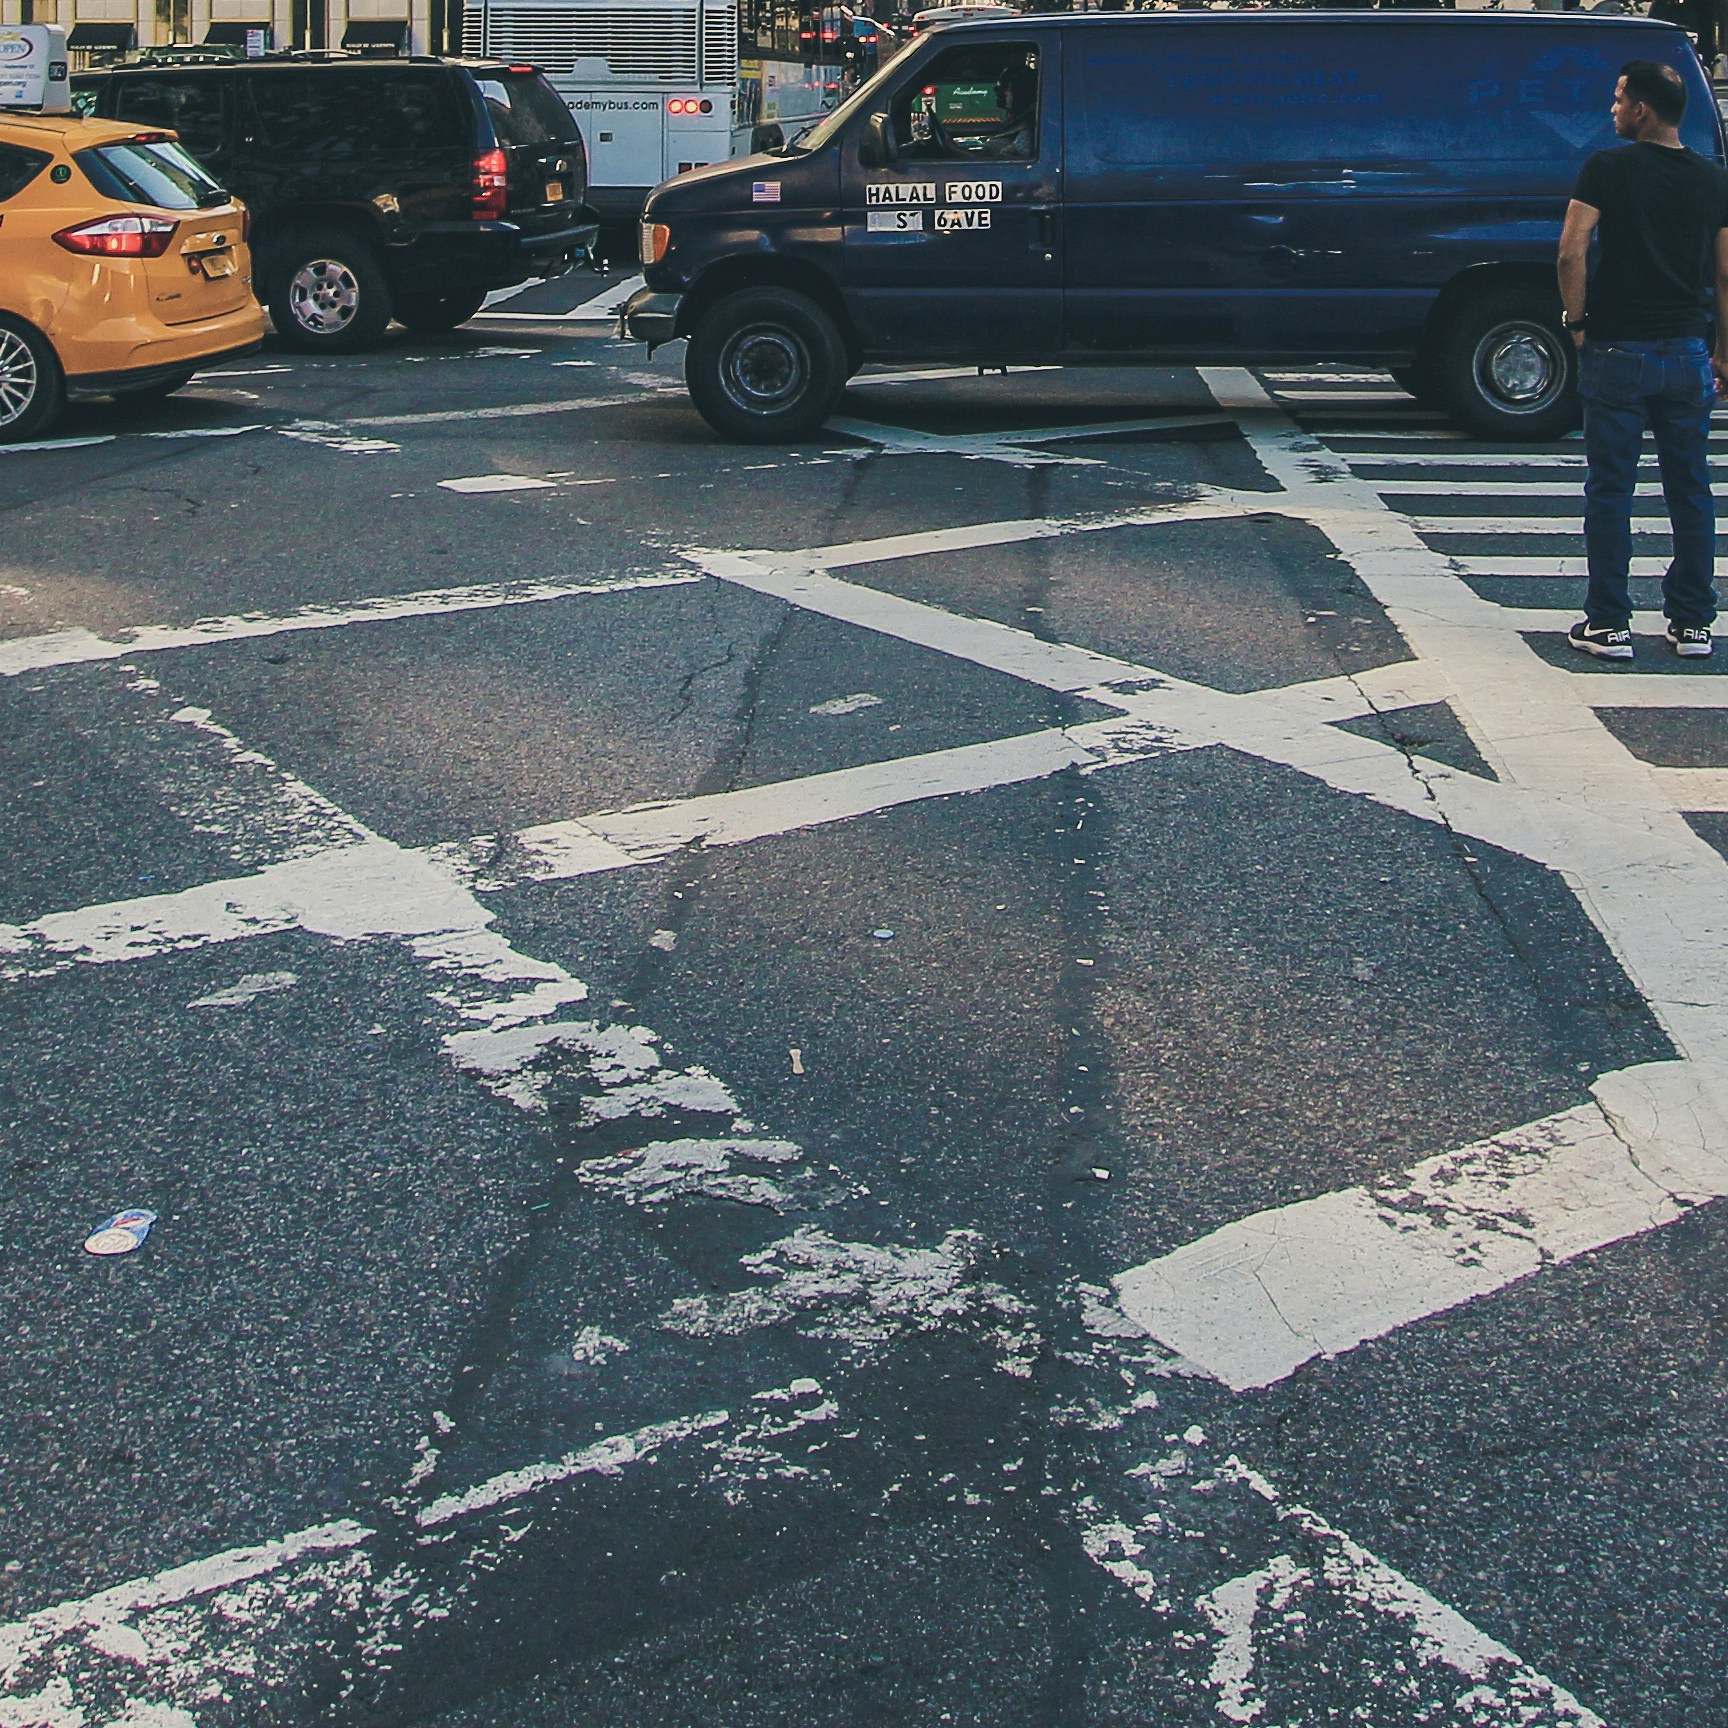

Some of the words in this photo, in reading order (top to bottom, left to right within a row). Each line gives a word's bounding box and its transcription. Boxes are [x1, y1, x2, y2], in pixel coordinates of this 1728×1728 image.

[567, 99, 659, 112] ademybus.com
[868, 186, 934, 203] HALAL
[948, 184, 1000, 201] FOOD
